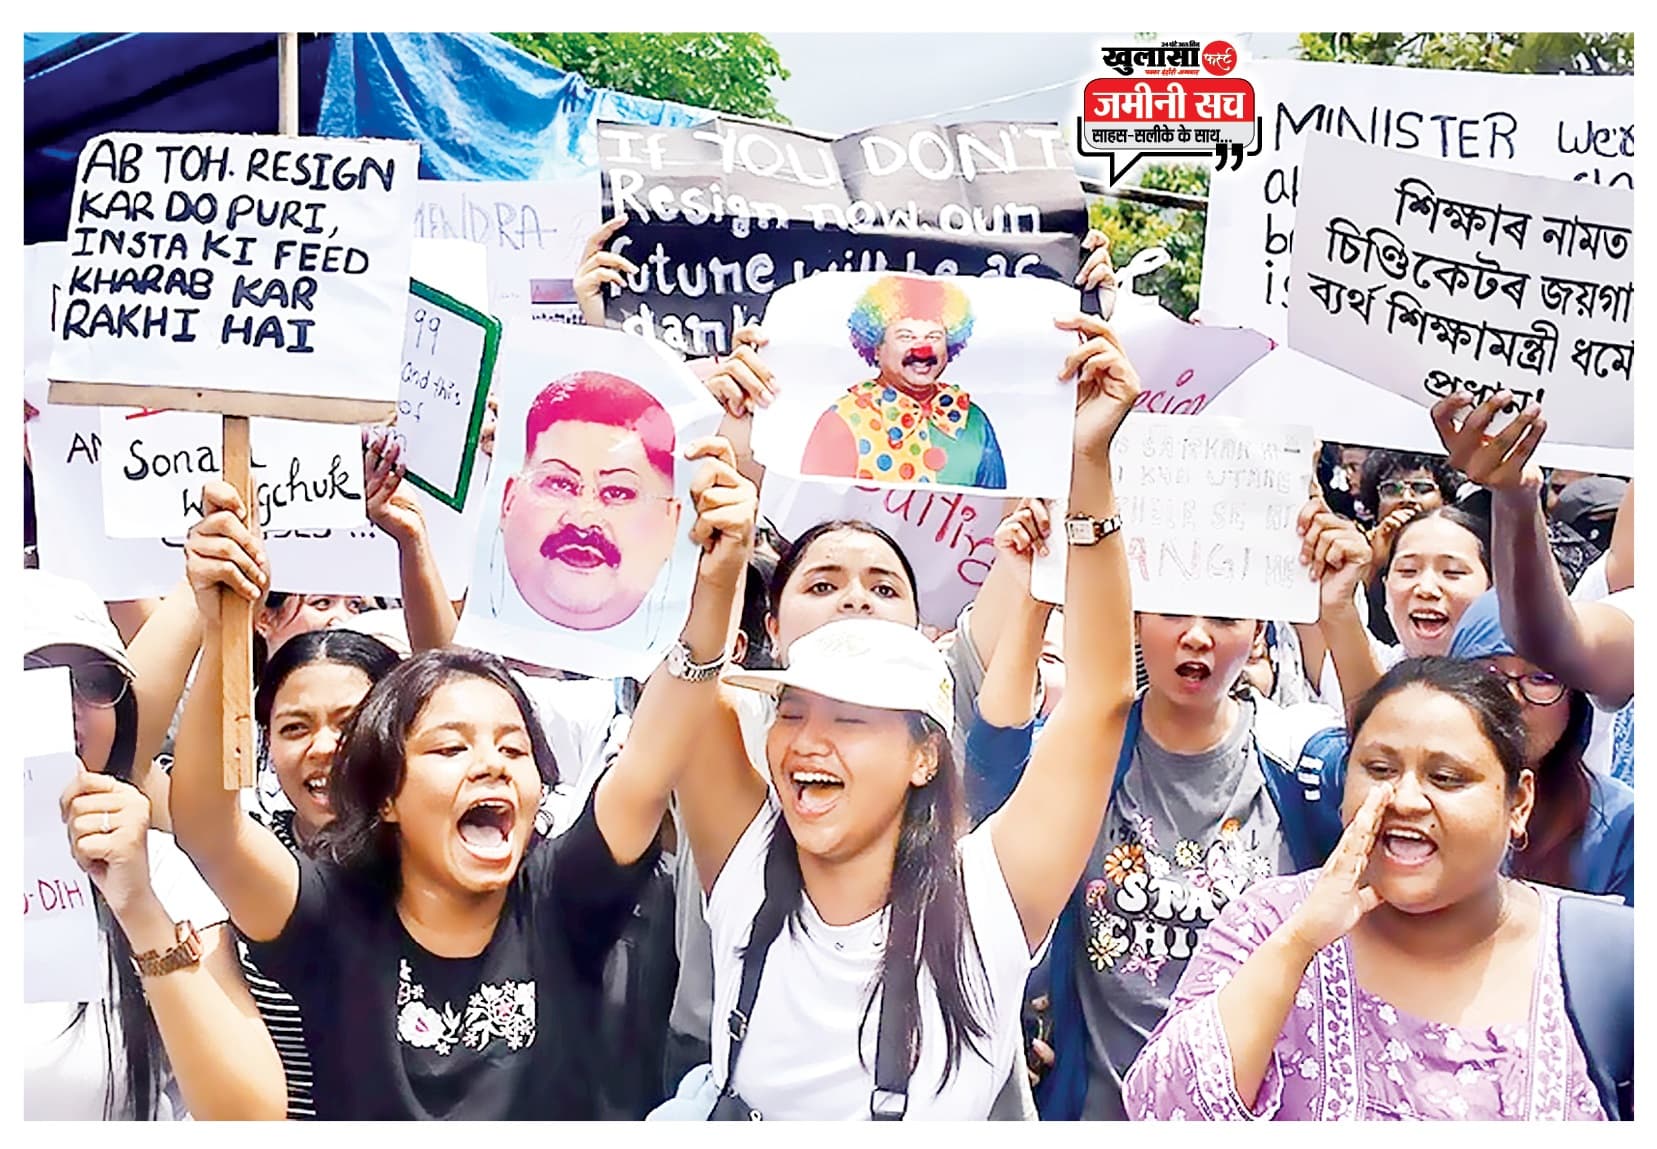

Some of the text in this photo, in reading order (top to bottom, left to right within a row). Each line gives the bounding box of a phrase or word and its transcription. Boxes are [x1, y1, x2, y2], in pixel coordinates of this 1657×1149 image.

[600, 124, 1062, 188] If YOU DON'T
[1274, 101, 1518, 159] MINISTER
[82, 138, 144, 184] AB
[247, 148, 396, 192] RESIGN
[78, 189, 339, 239] KAR DO PURI,
[610, 168, 789, 238] Resign
[71, 227, 370, 274] INSTA KI FEED
[1543, 214, 1633, 260] নামত
[69, 264, 318, 311] KHARAB KAR
[63, 298, 317, 353] RAKHI HAI
[124, 440, 266, 481] Sona
[183, 455, 361, 526] Wgchuk
